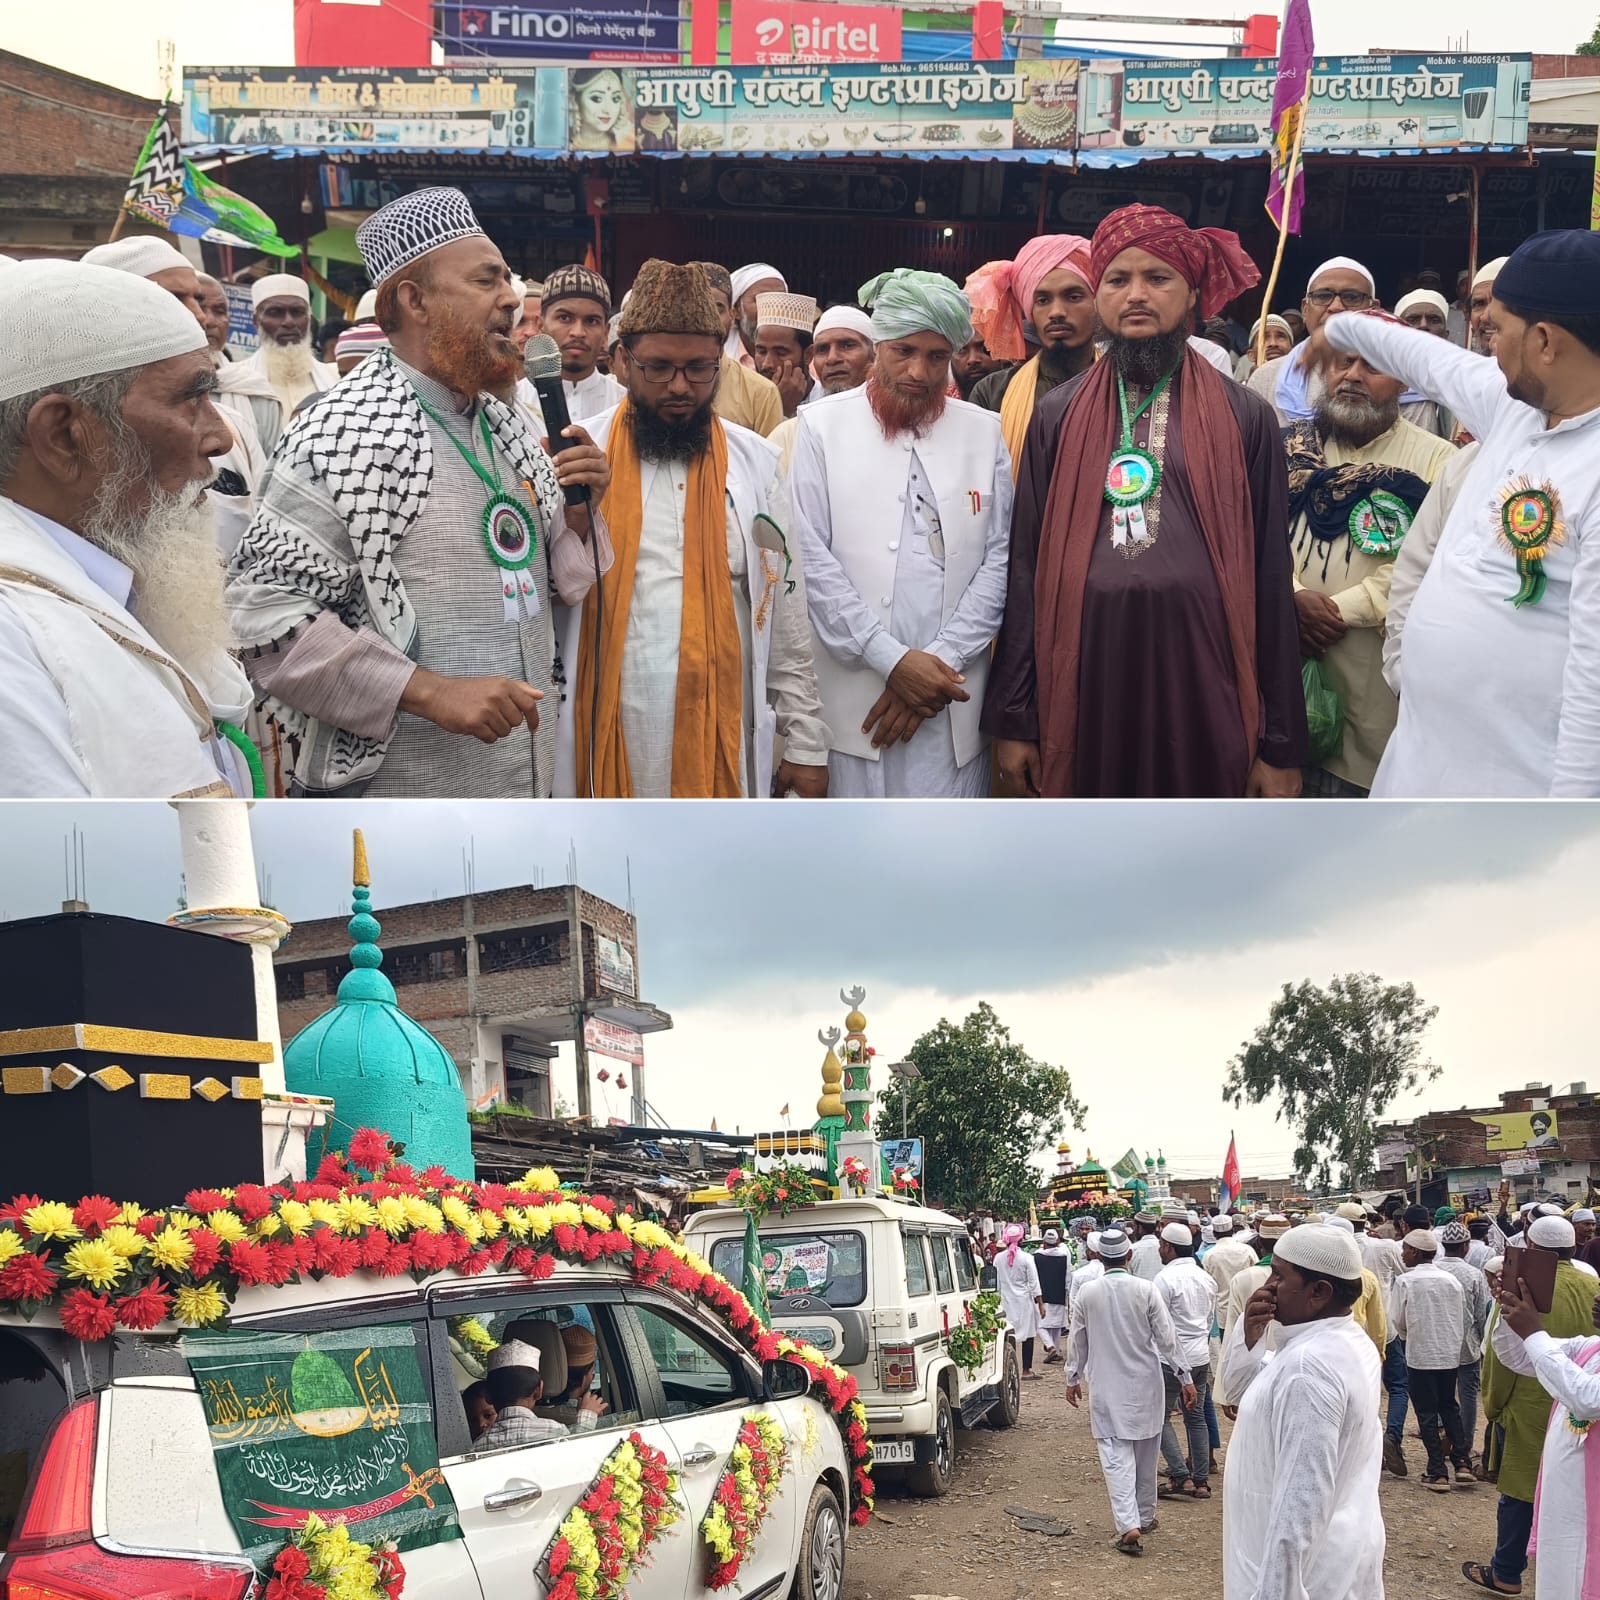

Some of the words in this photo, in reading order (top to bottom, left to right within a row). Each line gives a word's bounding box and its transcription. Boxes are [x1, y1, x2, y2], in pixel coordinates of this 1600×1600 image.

[491, 5, 569, 38] Fino
[576, 23, 601, 36] फिनो
[794, 17, 880, 52] airtel
[1427, 56, 1456, 65] Mob.No
[360, 82, 376, 107] &
[637, 70, 736, 117] आयुषी
[742, 78, 826, 106] चन्दन
[1126, 69, 1214, 112] आयुषी
[1310, 64, 1463, 106] ण्टरप्राइजेज
[229, 331, 260, 348] ATM
[874, 1444, 911, 1459] H7019
